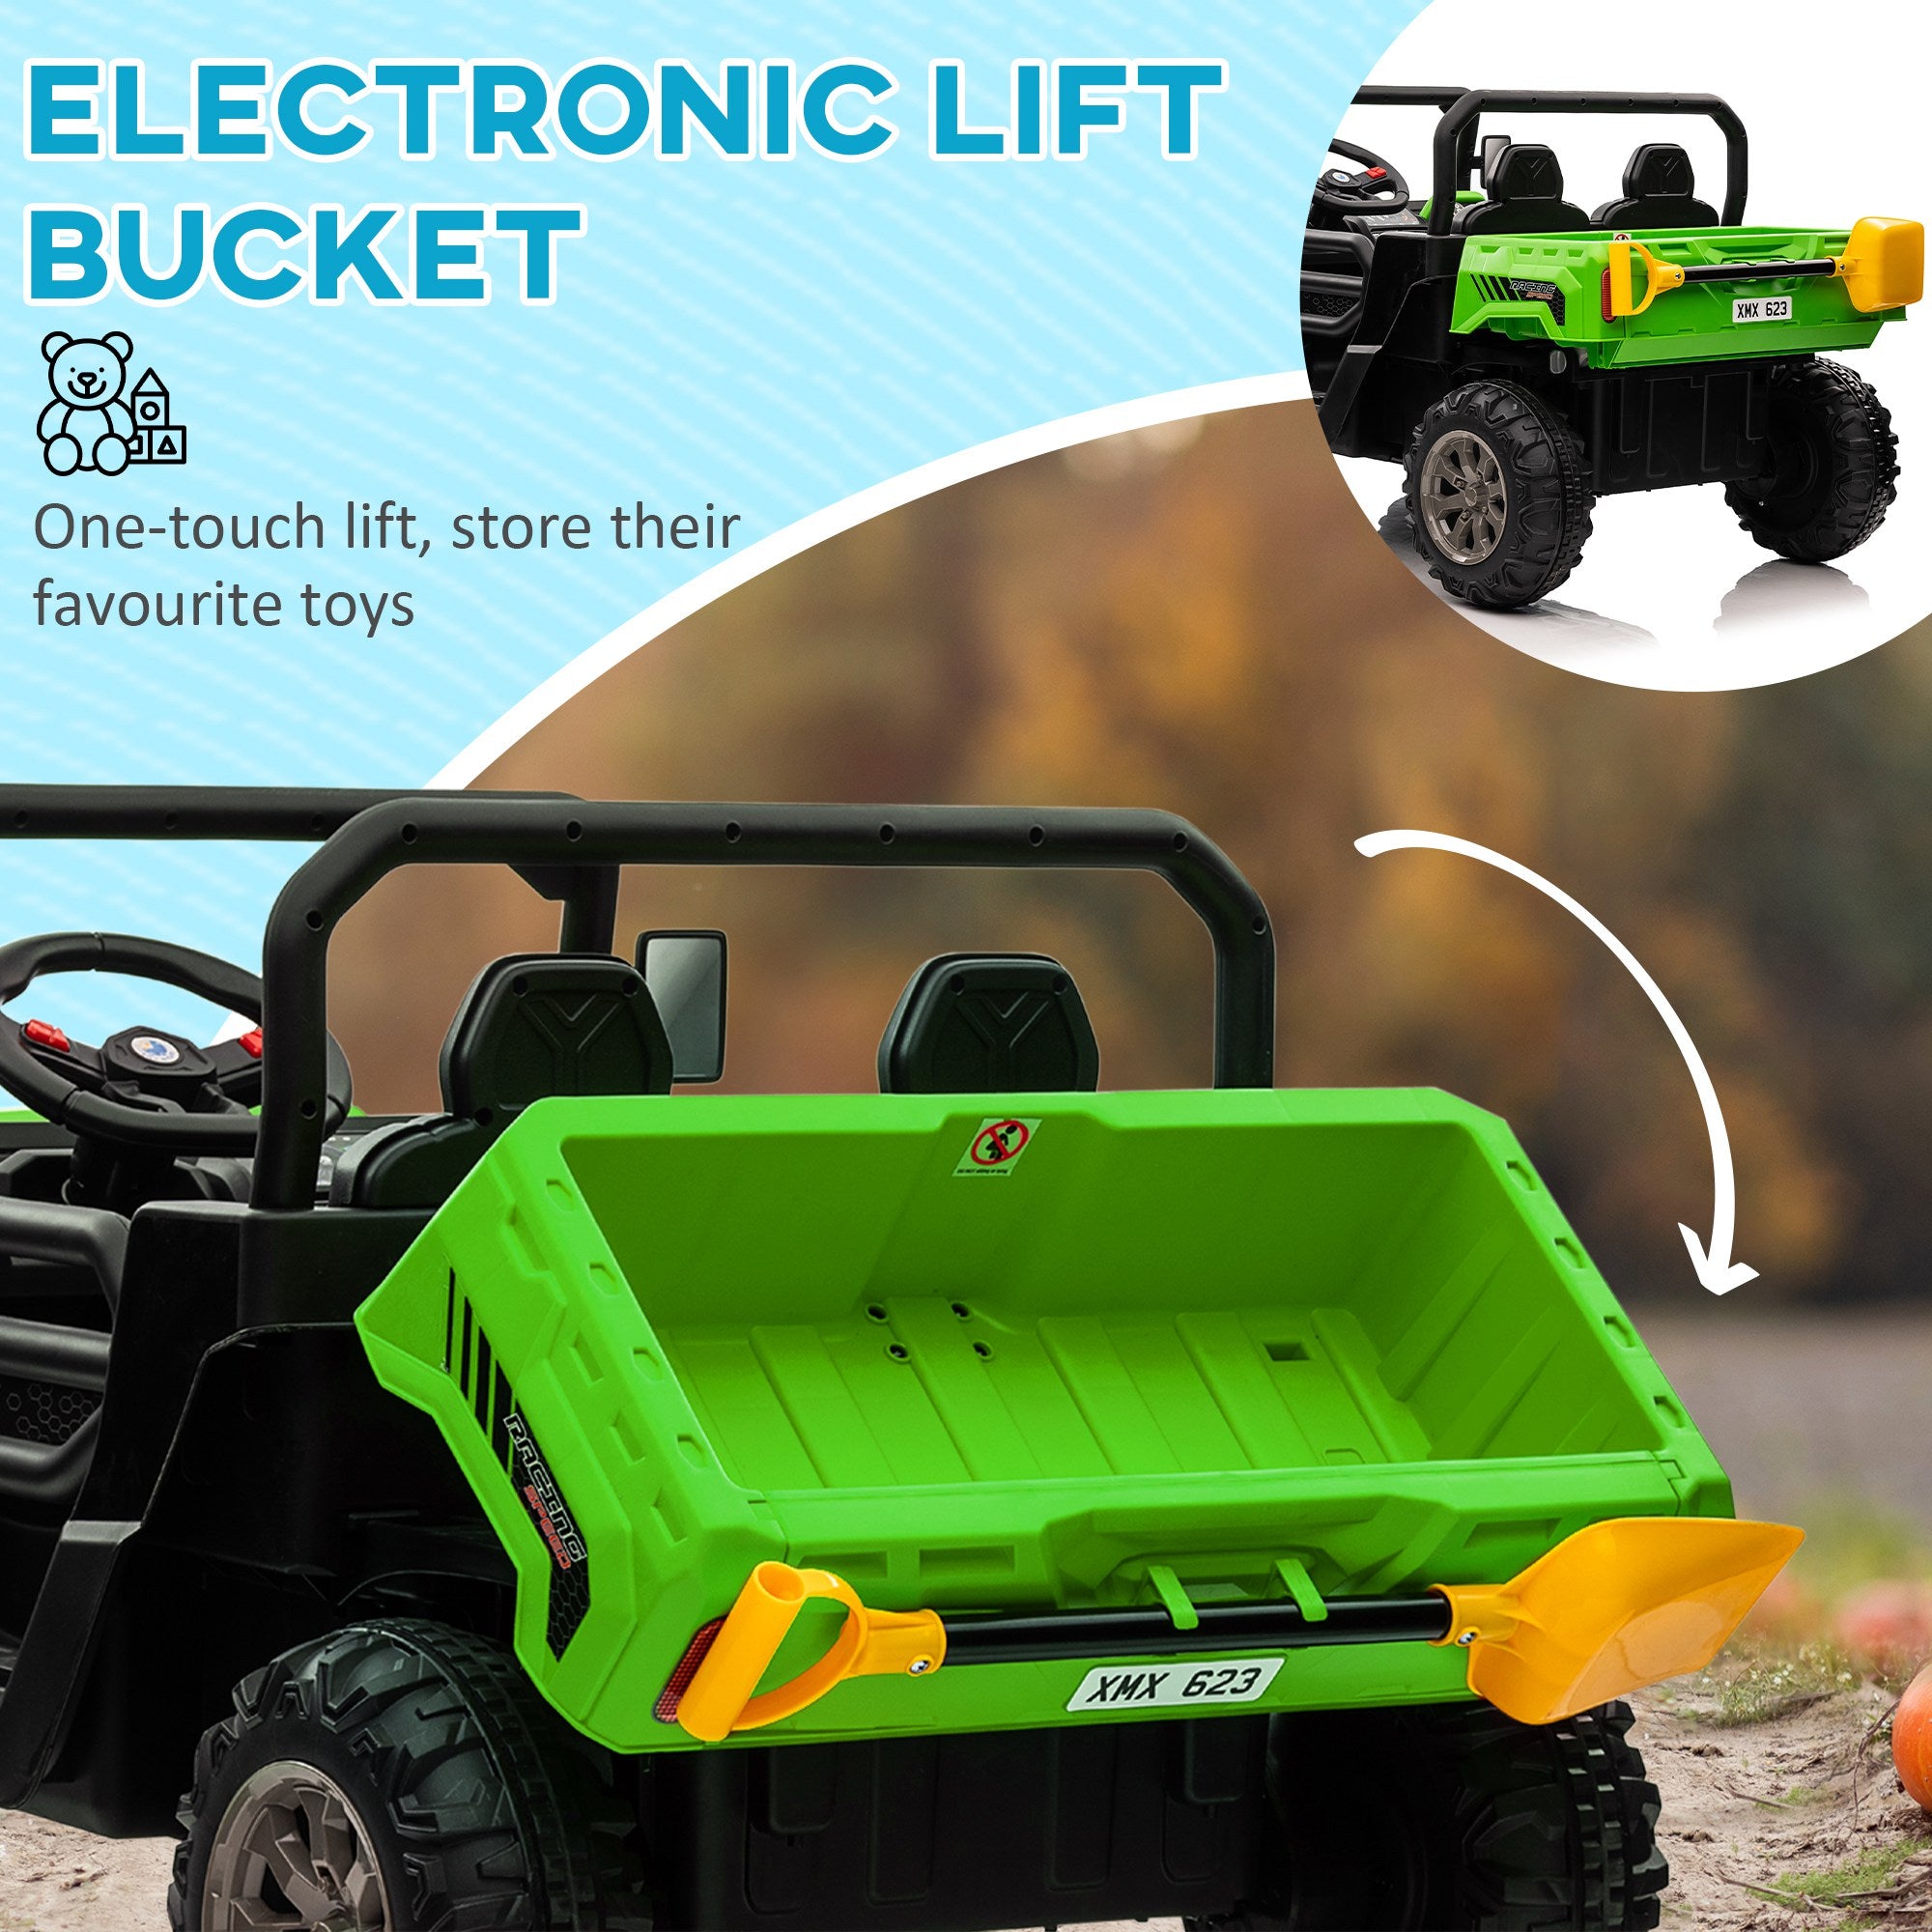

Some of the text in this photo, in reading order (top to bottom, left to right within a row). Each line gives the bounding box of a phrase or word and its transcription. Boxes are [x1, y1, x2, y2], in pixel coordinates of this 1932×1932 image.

[1737, 300, 1787, 319] XMX 623
[1086, 1666, 1263, 1703] XMX 623
